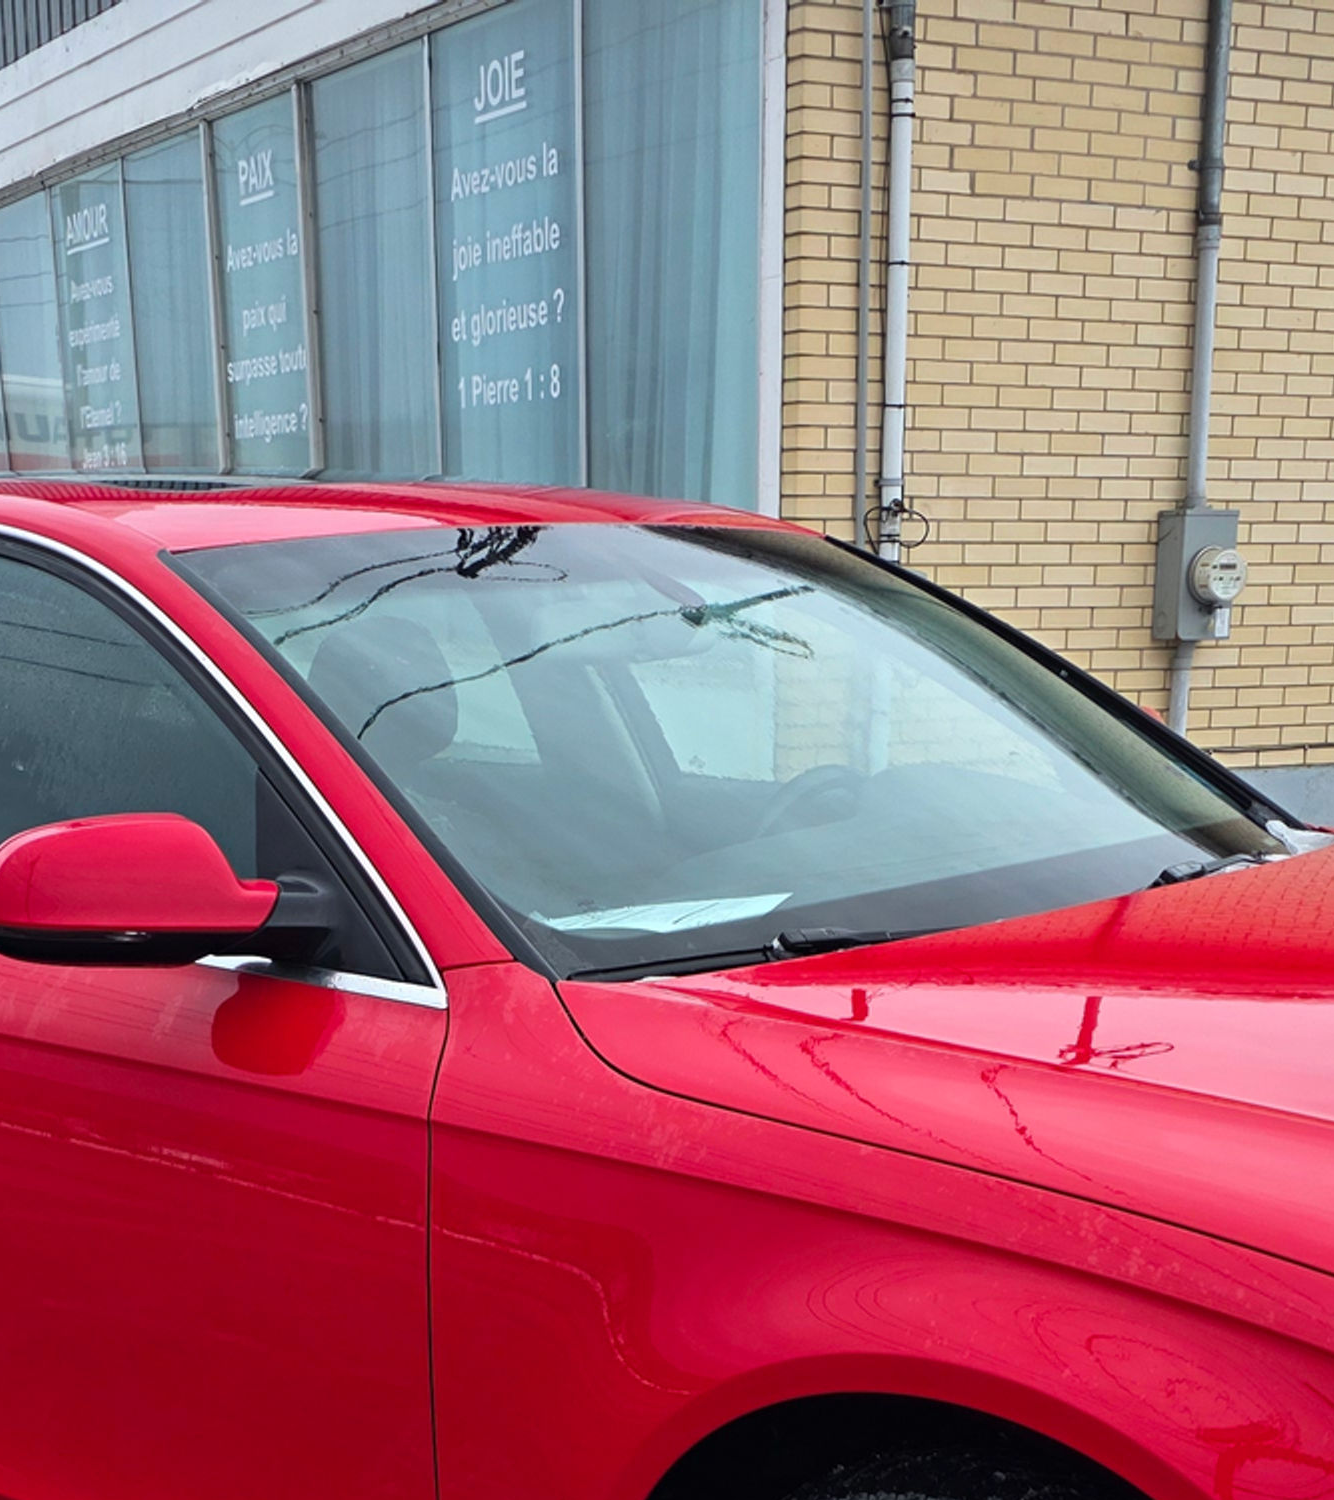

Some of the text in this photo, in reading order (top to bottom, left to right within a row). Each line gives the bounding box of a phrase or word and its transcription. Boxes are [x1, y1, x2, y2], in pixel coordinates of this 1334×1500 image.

[474, 50, 525, 111] JOIE
[238, 149, 274, 196] PAIX
[451, 142, 558, 202] Avez-vous la
[67, 203, 108, 246] AMOUR
[227, 228, 298, 272] Avez-vous la
[452, 216, 560, 281] joie ineffable
[242, 295, 287, 337] paix qui
[451, 288, 564, 347] et glorieuse ?
[227, 355, 278, 386] surpasse
[458, 376, 466, 409] 1
[471, 374, 518, 406] Pierre
[524, 367, 532, 400] 1
[550, 364, 560, 398] 8
[234, 403, 308, 443] intelligence ?
